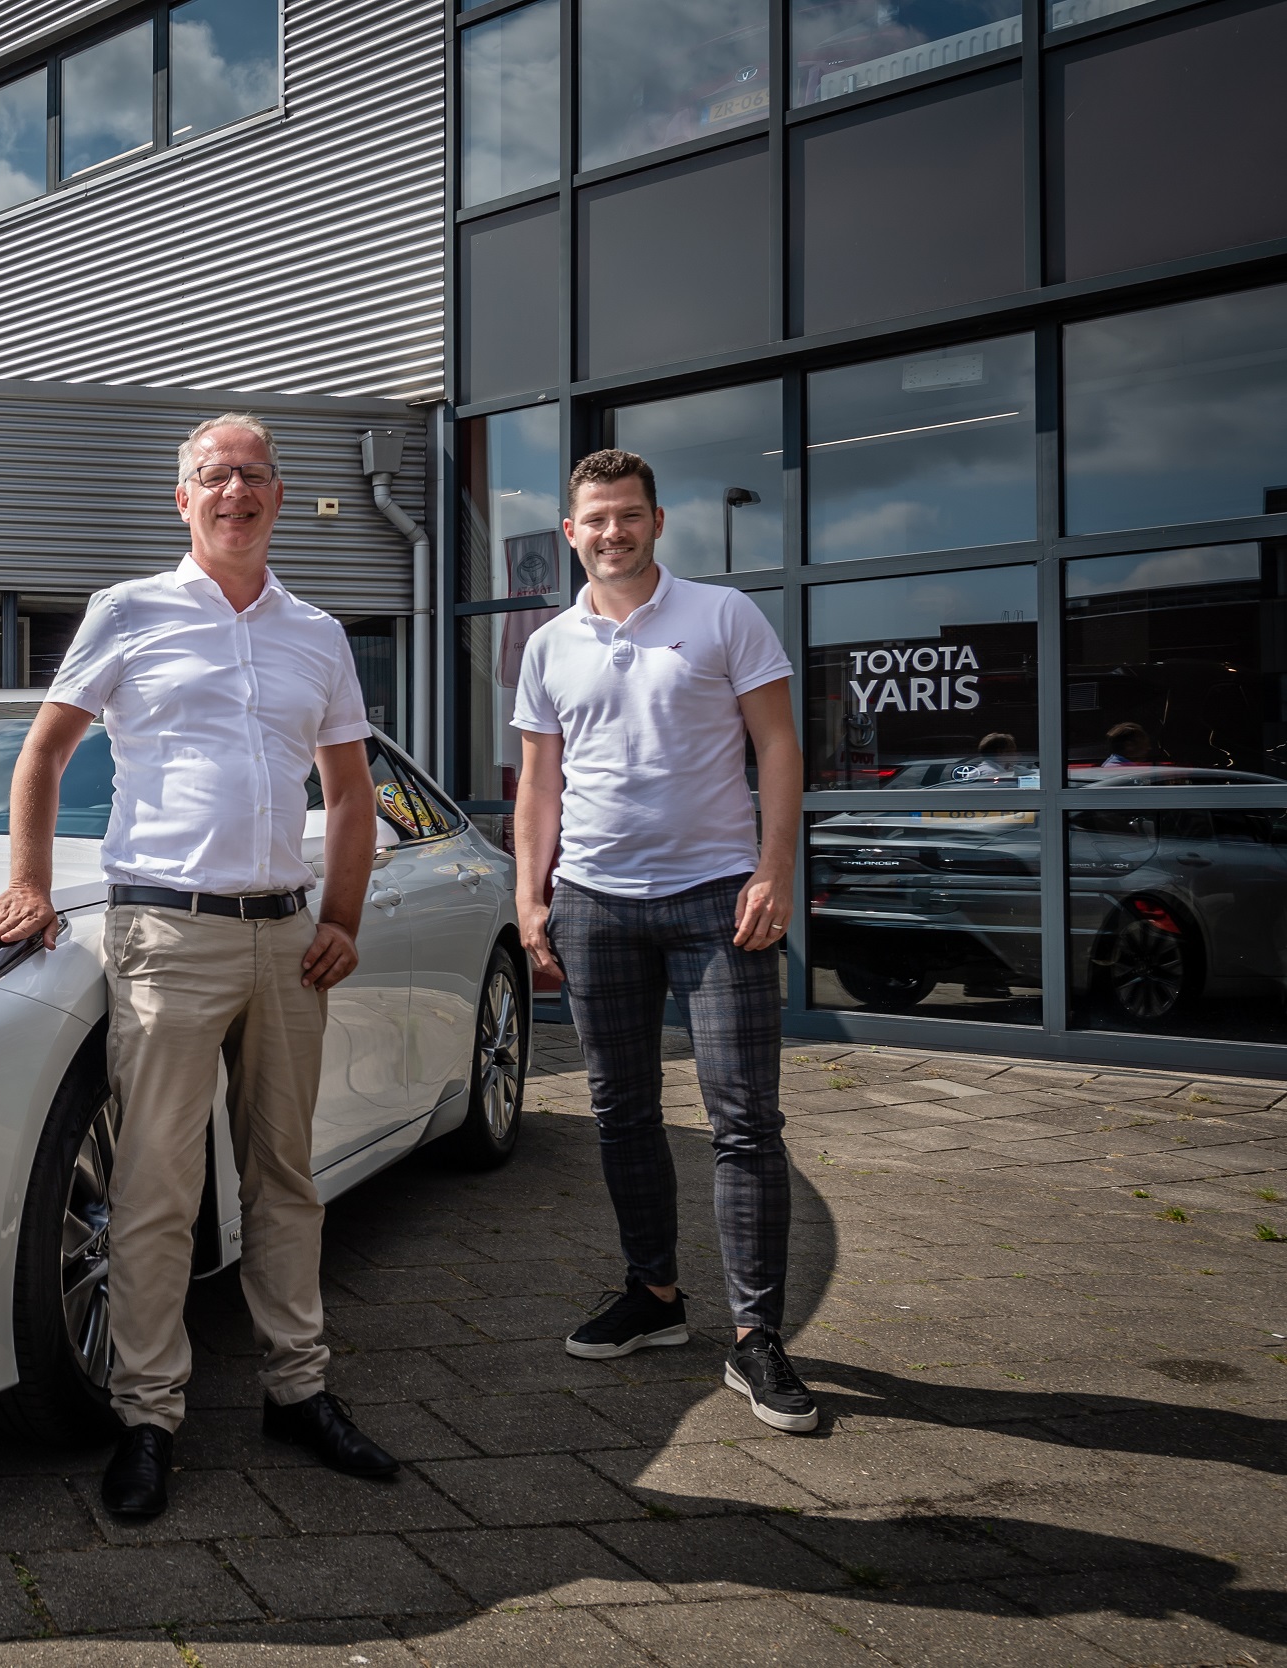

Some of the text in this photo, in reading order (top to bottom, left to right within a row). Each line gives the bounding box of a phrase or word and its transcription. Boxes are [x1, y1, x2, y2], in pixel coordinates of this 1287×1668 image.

[713, 91, 769, 120] ZR-06
[849, 645, 979, 675] TOYOTA
[849, 675, 980, 713] YARIS
